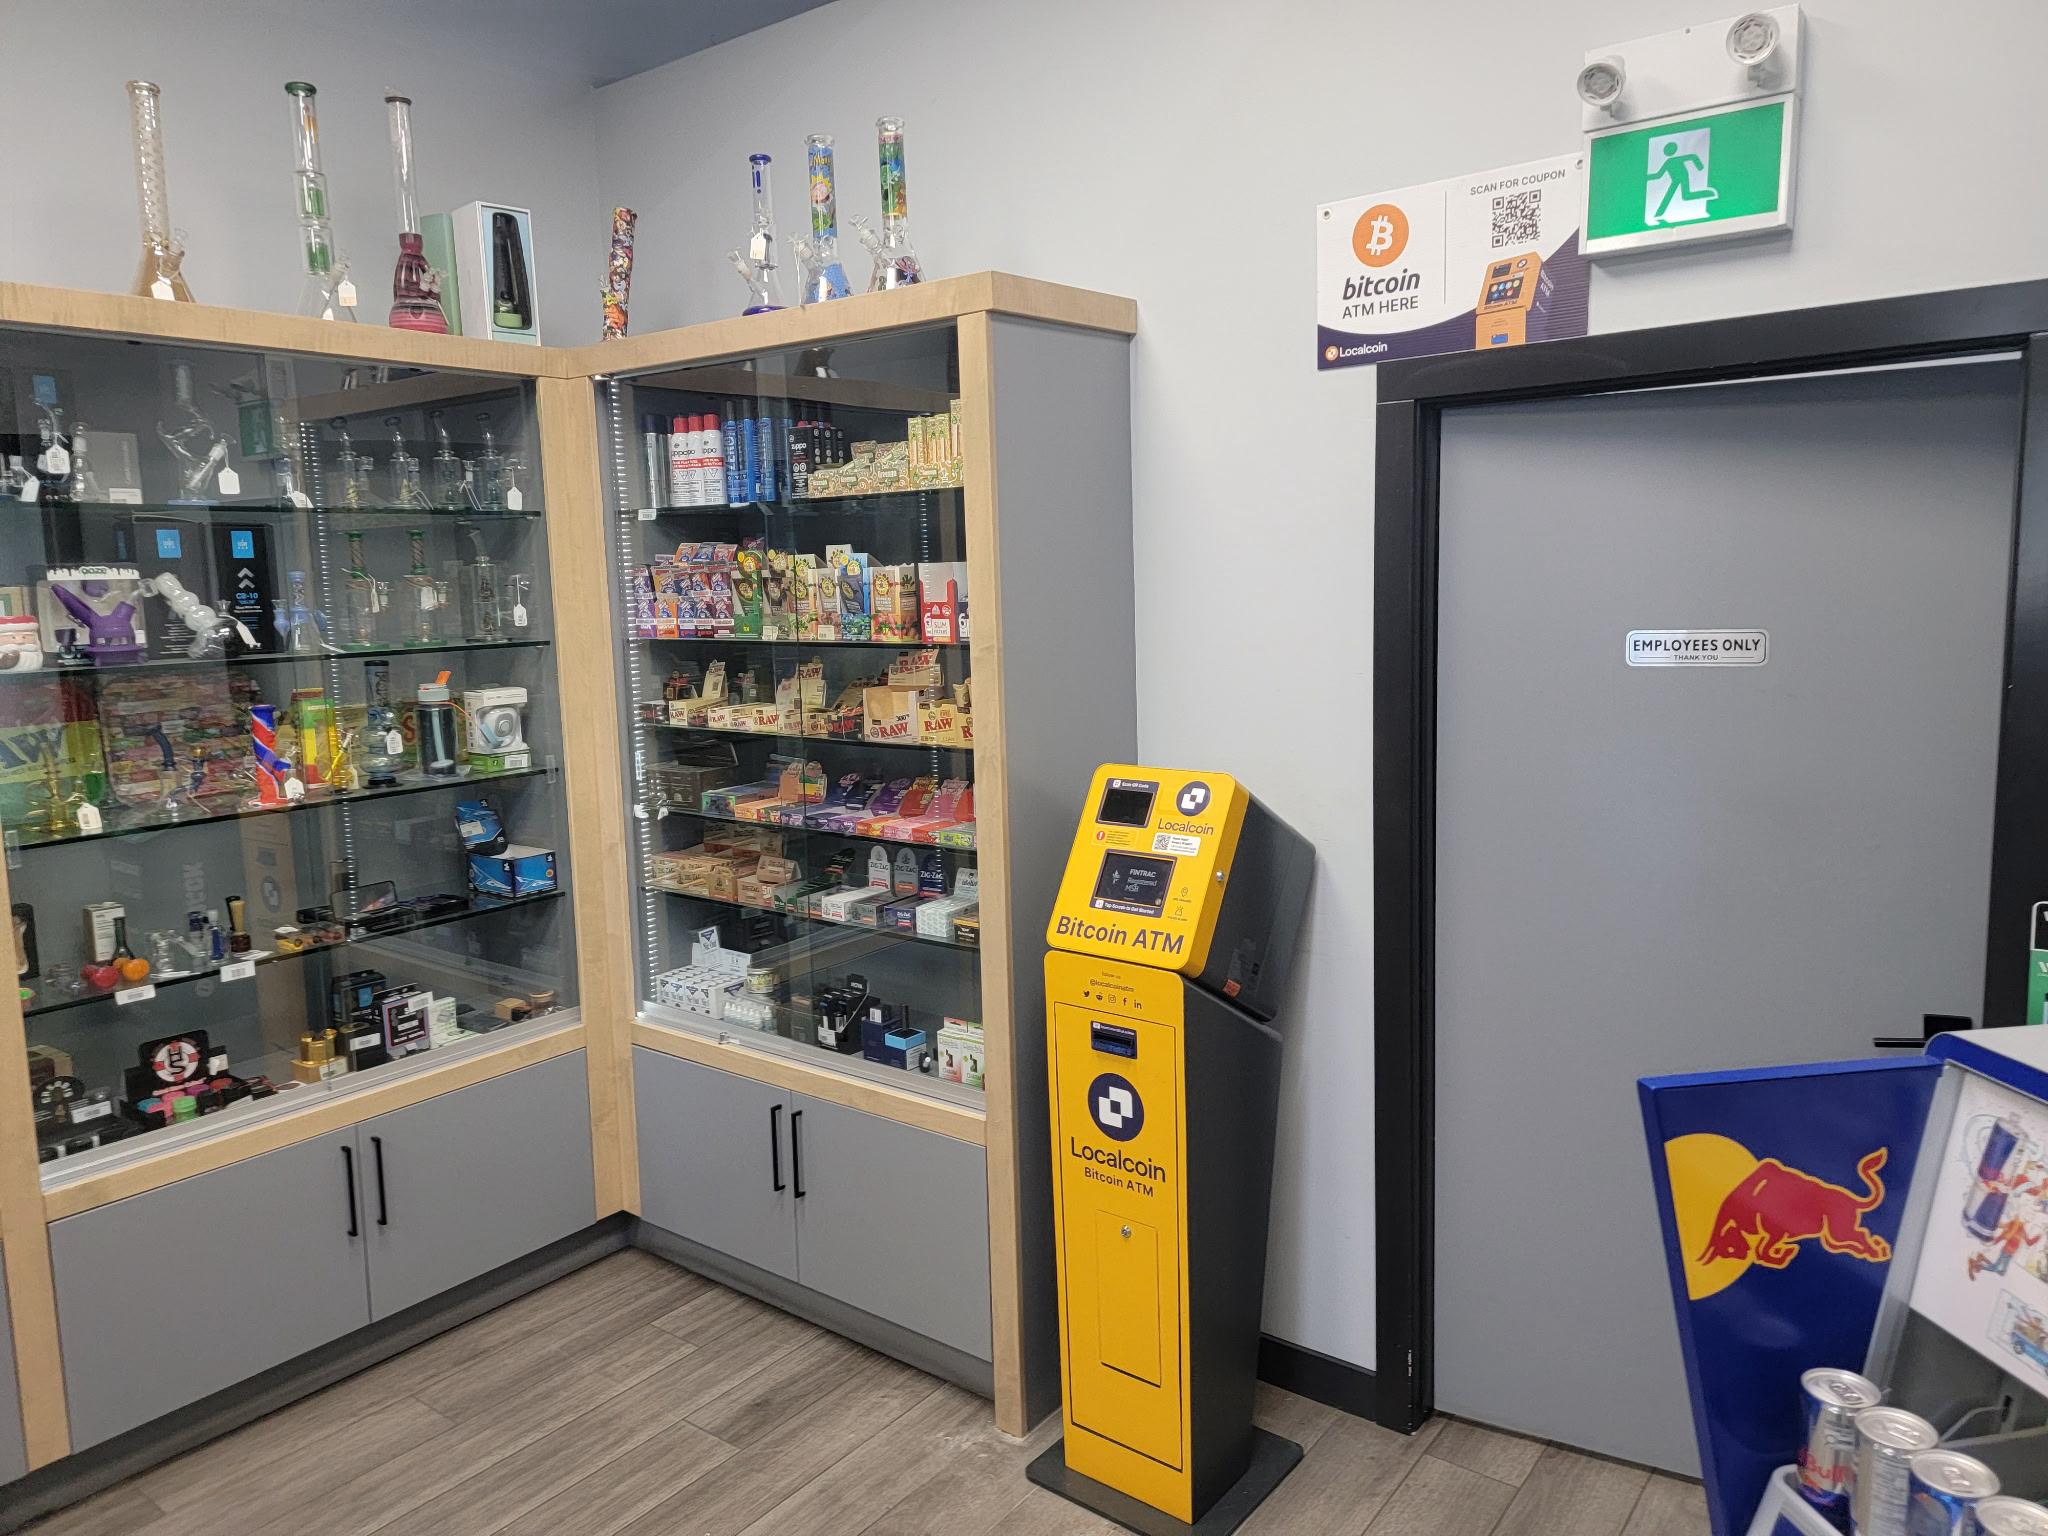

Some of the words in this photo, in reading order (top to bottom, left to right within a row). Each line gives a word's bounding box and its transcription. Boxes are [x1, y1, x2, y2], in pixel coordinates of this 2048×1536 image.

[1470, 182, 1497, 196] SCAN
[1499, 177, 1519, 190] FOR
[1521, 169, 1566, 187] COUPON
[1342, 268, 1421, 300] bitcoin
[1342, 303, 1375, 319] ATM
[1379, 295, 1419, 315] HERE
[1340, 341, 1388, 358] Localcoin
[1633, 639, 1718, 652] EMPLOYEES
[1722, 639, 1761, 651] ONLY
[798, 667, 822, 679] RAW
[757, 714, 780, 726] RAW
[923, 718, 953, 732] RAW
[879, 722, 909, 739] RAW
[1157, 818, 1215, 836] Localcoin
[1129, 868, 1158, 878] FINTRAC
[1056, 915, 1128, 946] Bitcoin
[1131, 928, 1185, 955] ATM
[1070, 1136, 1167, 1183] Localcoin
[1084, 1166, 1124, 1188] Bitcoin
[1126, 1179, 1154, 1197] ATM
